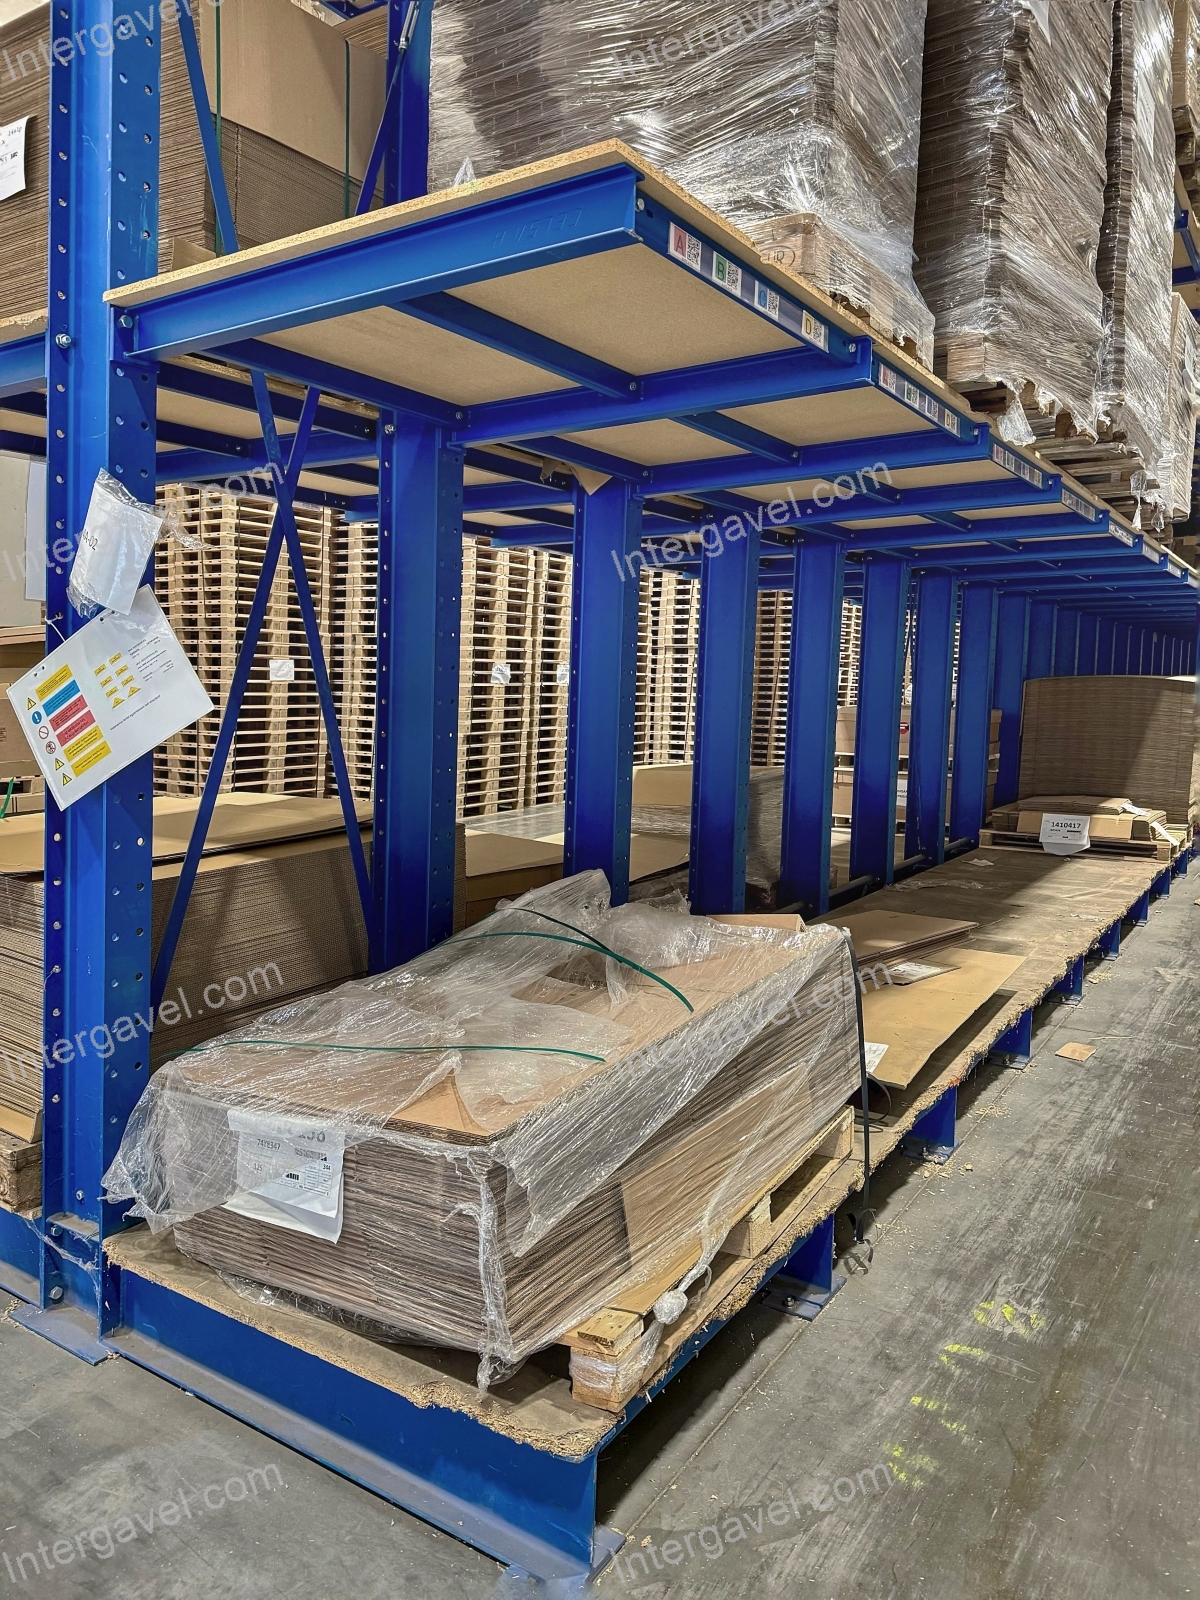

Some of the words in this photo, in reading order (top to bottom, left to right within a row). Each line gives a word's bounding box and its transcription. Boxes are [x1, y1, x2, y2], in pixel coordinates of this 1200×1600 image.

[675, 234, 686, 256] A
[717, 261, 725, 281] B
[805, 318, 812, 335] D
[1051, 821, 1081, 829] 1410417
